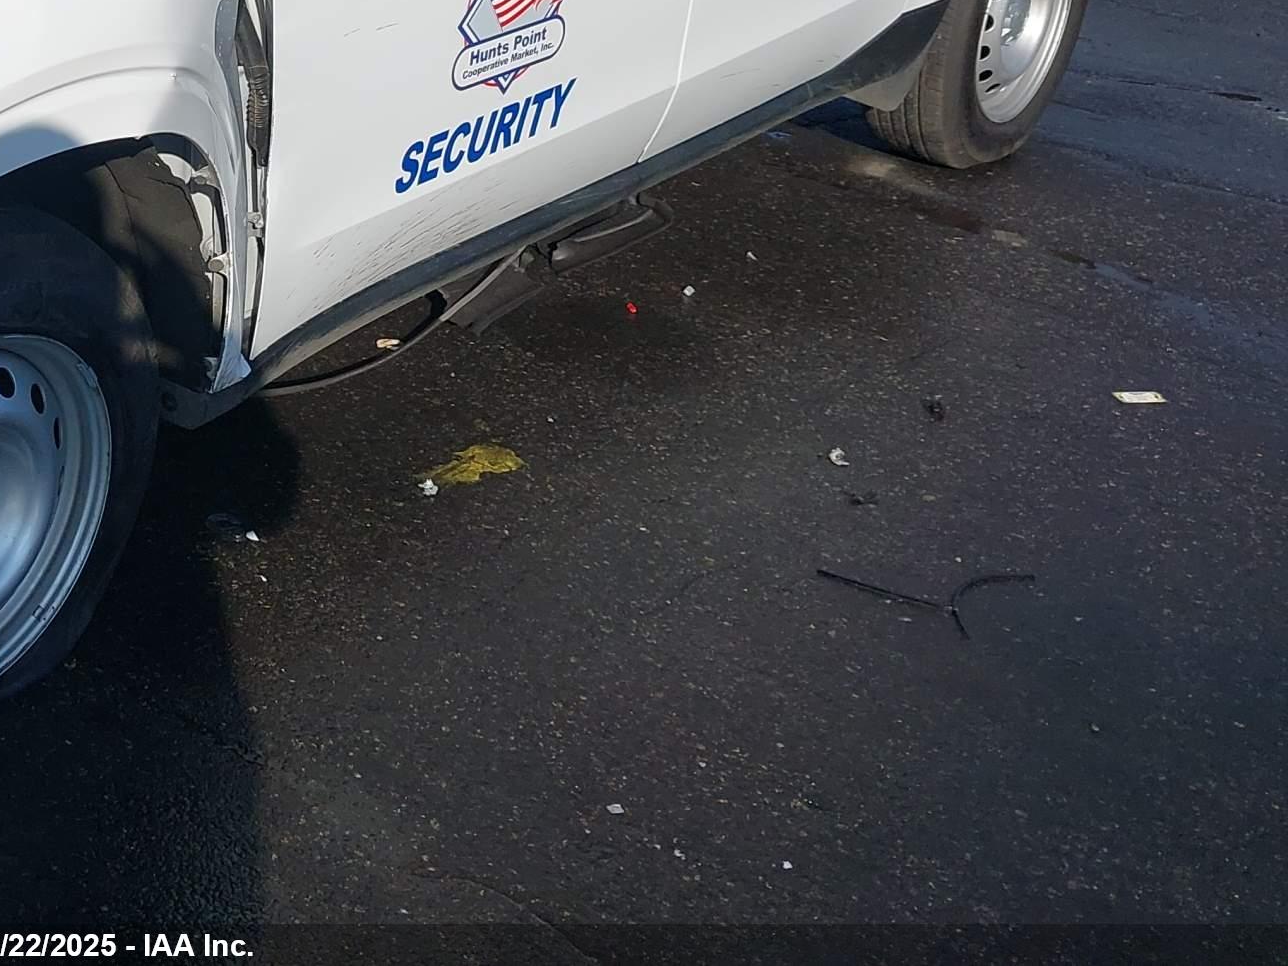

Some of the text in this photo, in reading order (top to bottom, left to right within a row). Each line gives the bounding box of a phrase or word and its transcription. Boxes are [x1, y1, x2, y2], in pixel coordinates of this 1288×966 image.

[462, 41, 554, 80] Cooperative Market, Inc.
[469, 26, 547, 66] Hunts Point
[395, 77, 578, 194] SECURITY
